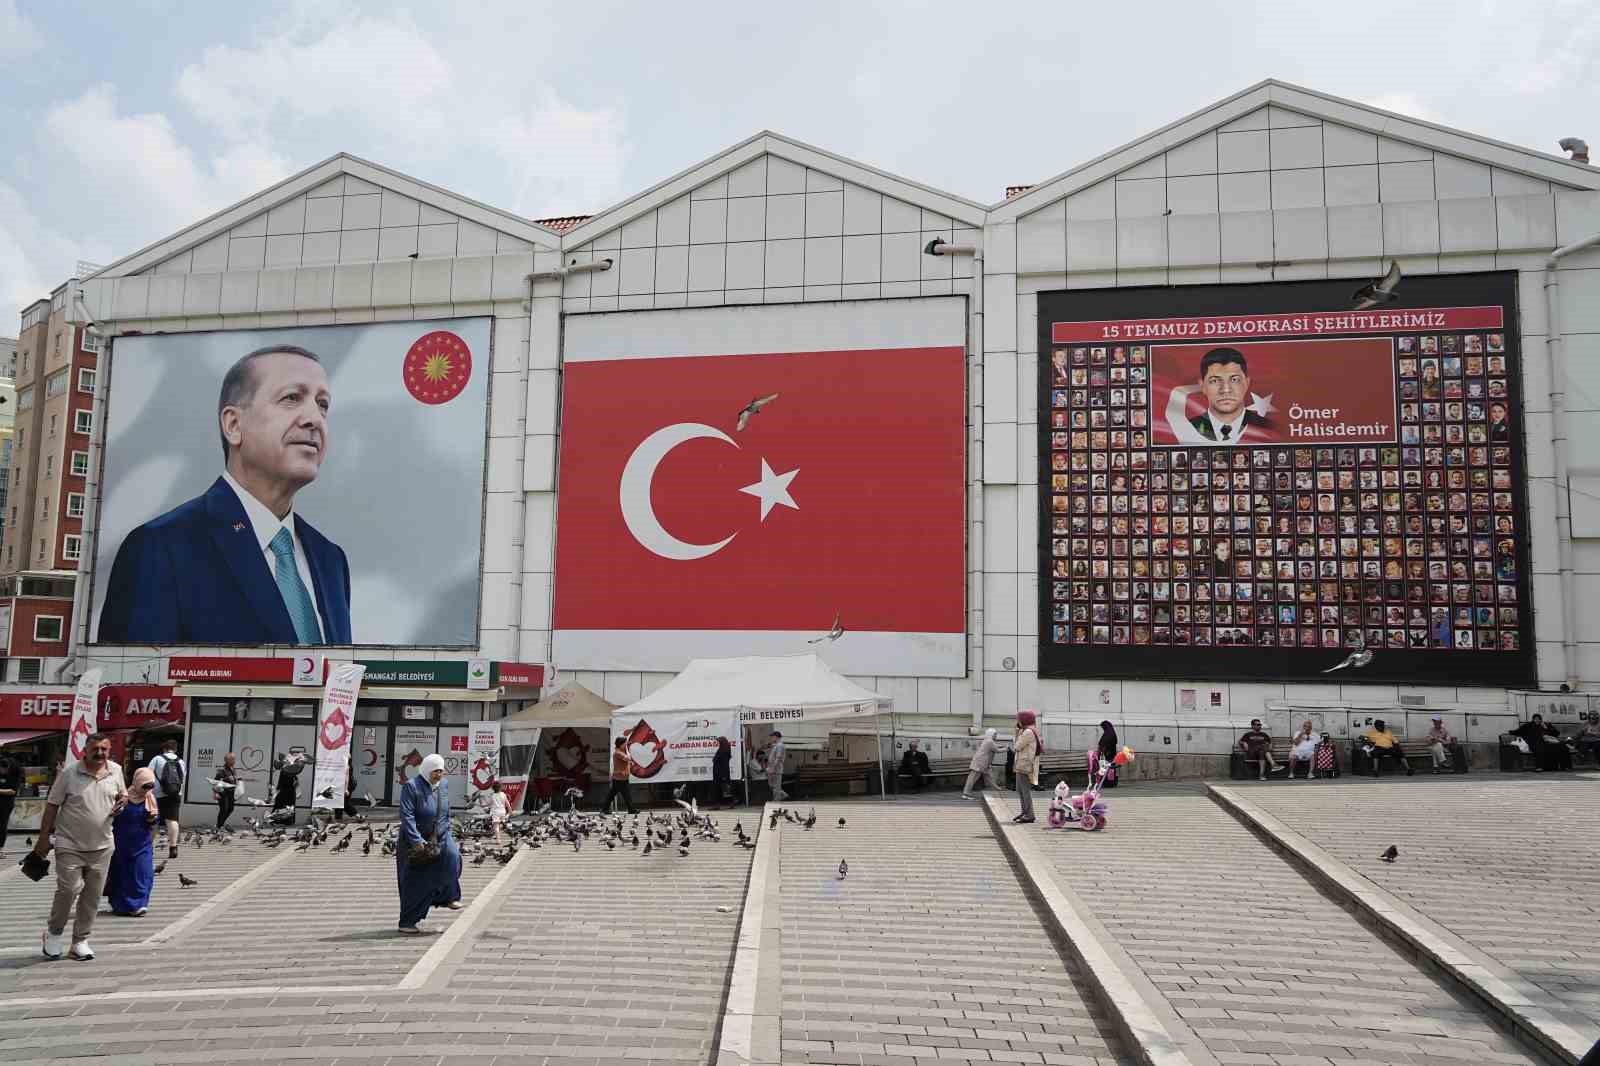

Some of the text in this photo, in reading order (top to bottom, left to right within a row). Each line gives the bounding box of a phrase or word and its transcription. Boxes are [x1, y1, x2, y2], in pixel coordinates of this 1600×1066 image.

[1102, 311, 1446, 338] 15 TEMMUZ DEMOKRASİ ŞEHİTLERİMİZ
[1289, 403, 1339, 420] Ömer
[1289, 421, 1389, 437] Halisdemir
[170, 669, 187, 677] KAN
[20, 695, 72, 716] BÜFE
[126, 698, 172, 714] AYAZ
[760, 708, 804, 720] BELEDİYESİ
